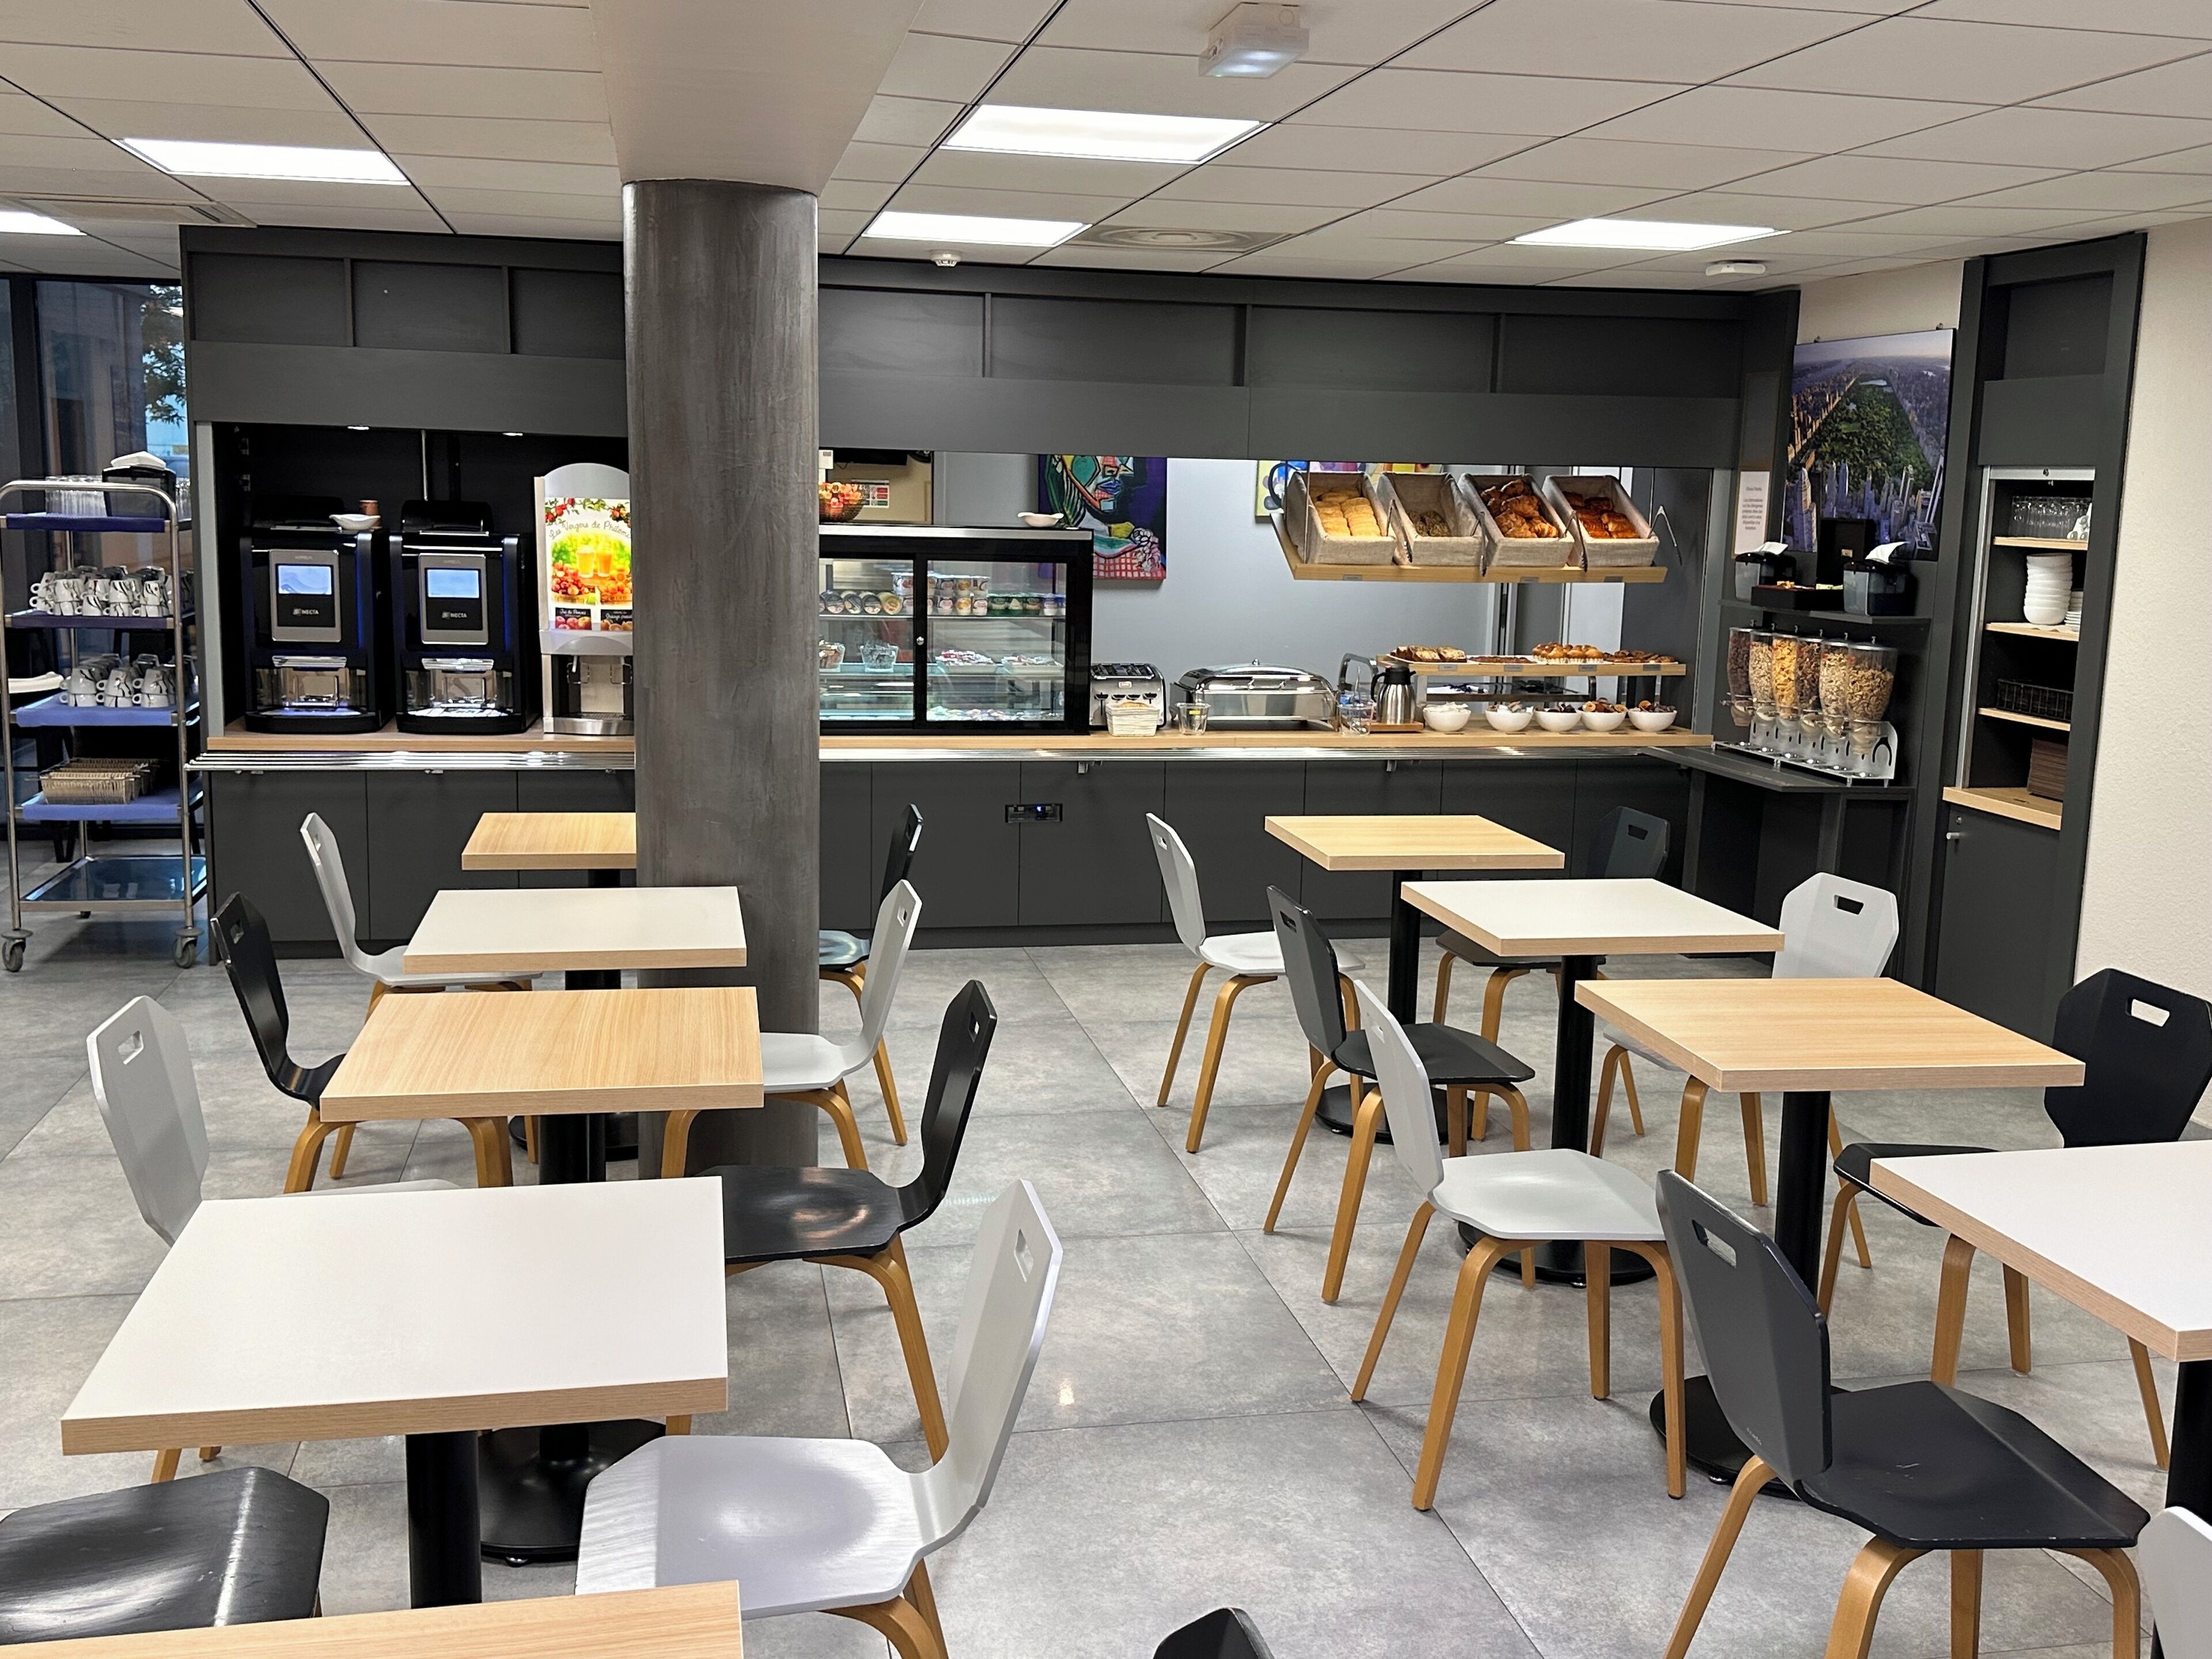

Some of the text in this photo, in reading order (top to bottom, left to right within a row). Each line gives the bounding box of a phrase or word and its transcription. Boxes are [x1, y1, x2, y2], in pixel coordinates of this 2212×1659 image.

[549, 529, 561, 540] Les
[562, 521, 589, 532] Vergers
[591, 520, 601, 529] de
